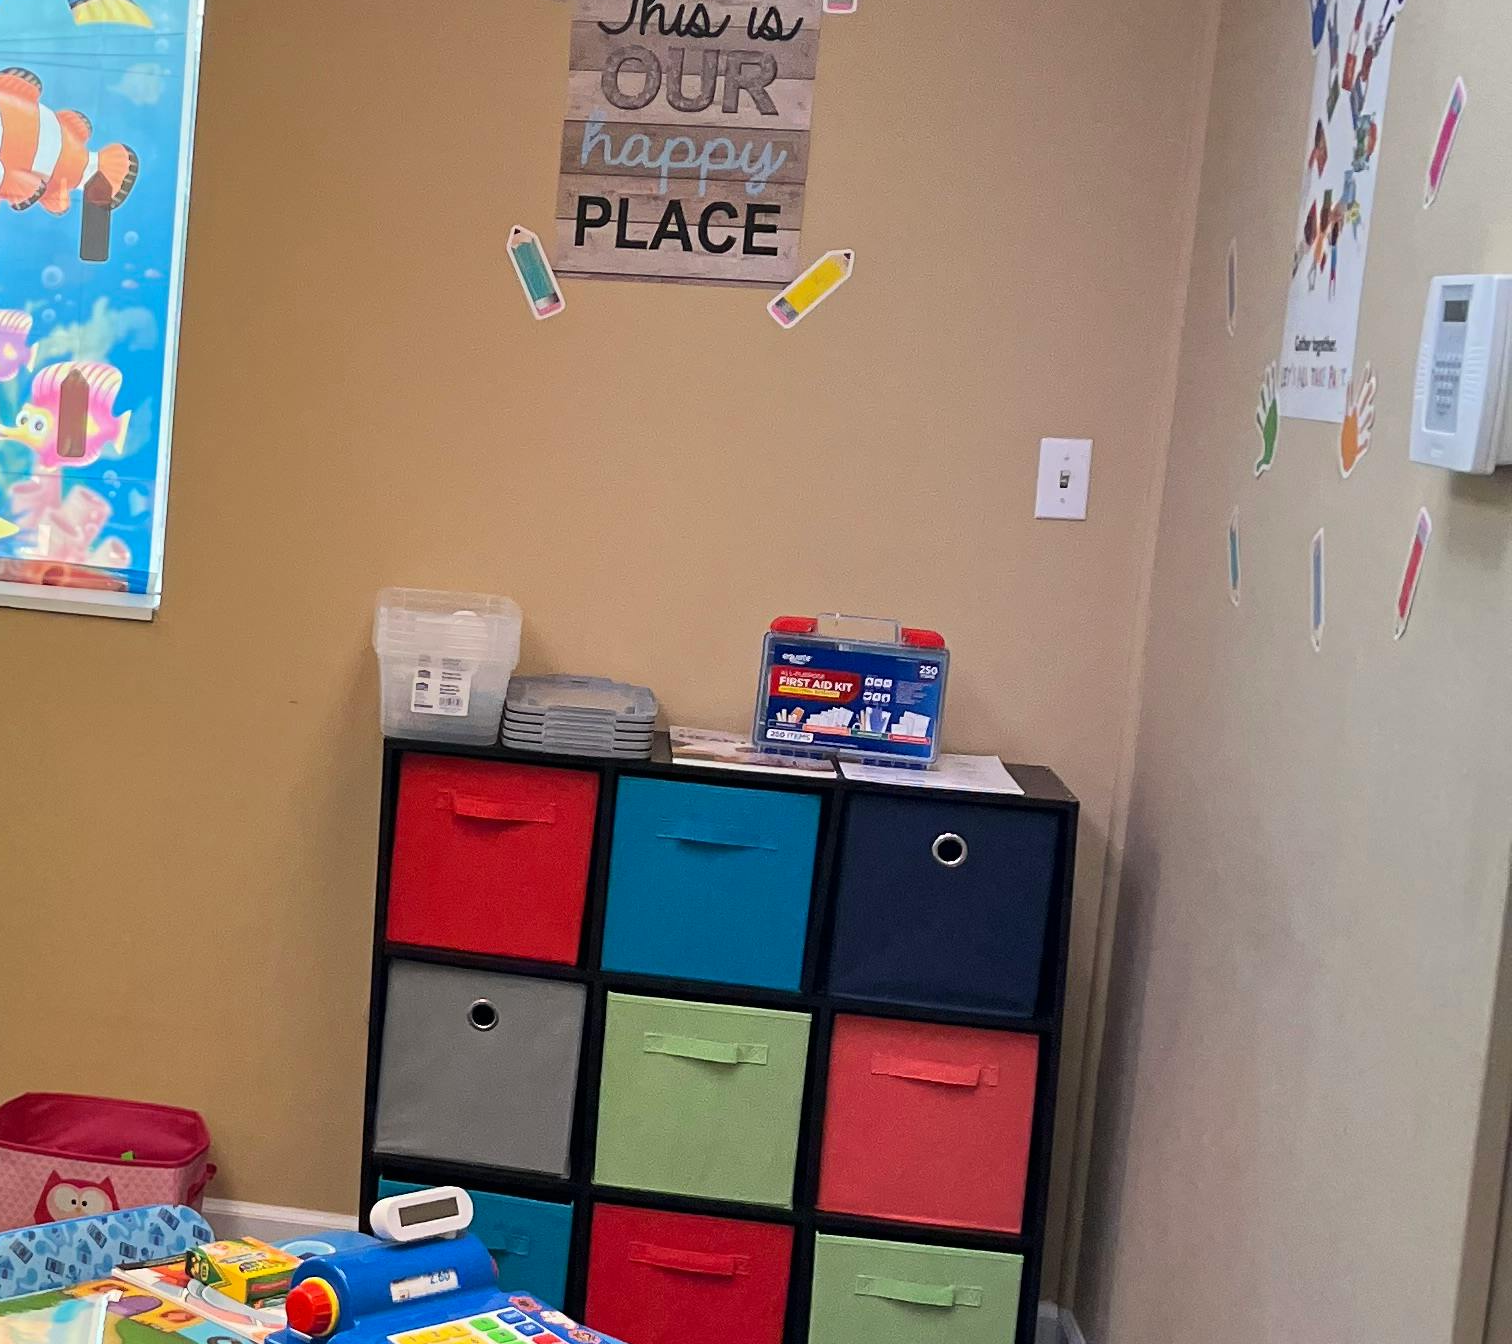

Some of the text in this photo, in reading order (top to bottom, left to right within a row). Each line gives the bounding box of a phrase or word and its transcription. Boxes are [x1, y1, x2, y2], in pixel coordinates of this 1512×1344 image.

[601, 45, 779, 116] OUR
[580, 107, 788, 197] happy
[574, 195, 781, 256] PLACE
[779, 676, 811, 687] FIRST
[812, 680, 833, 690] AID
[834, 682, 854, 693] KIT
[919, 665, 939, 675] 250
[769, 730, 811, 742] 250 ITEMS
